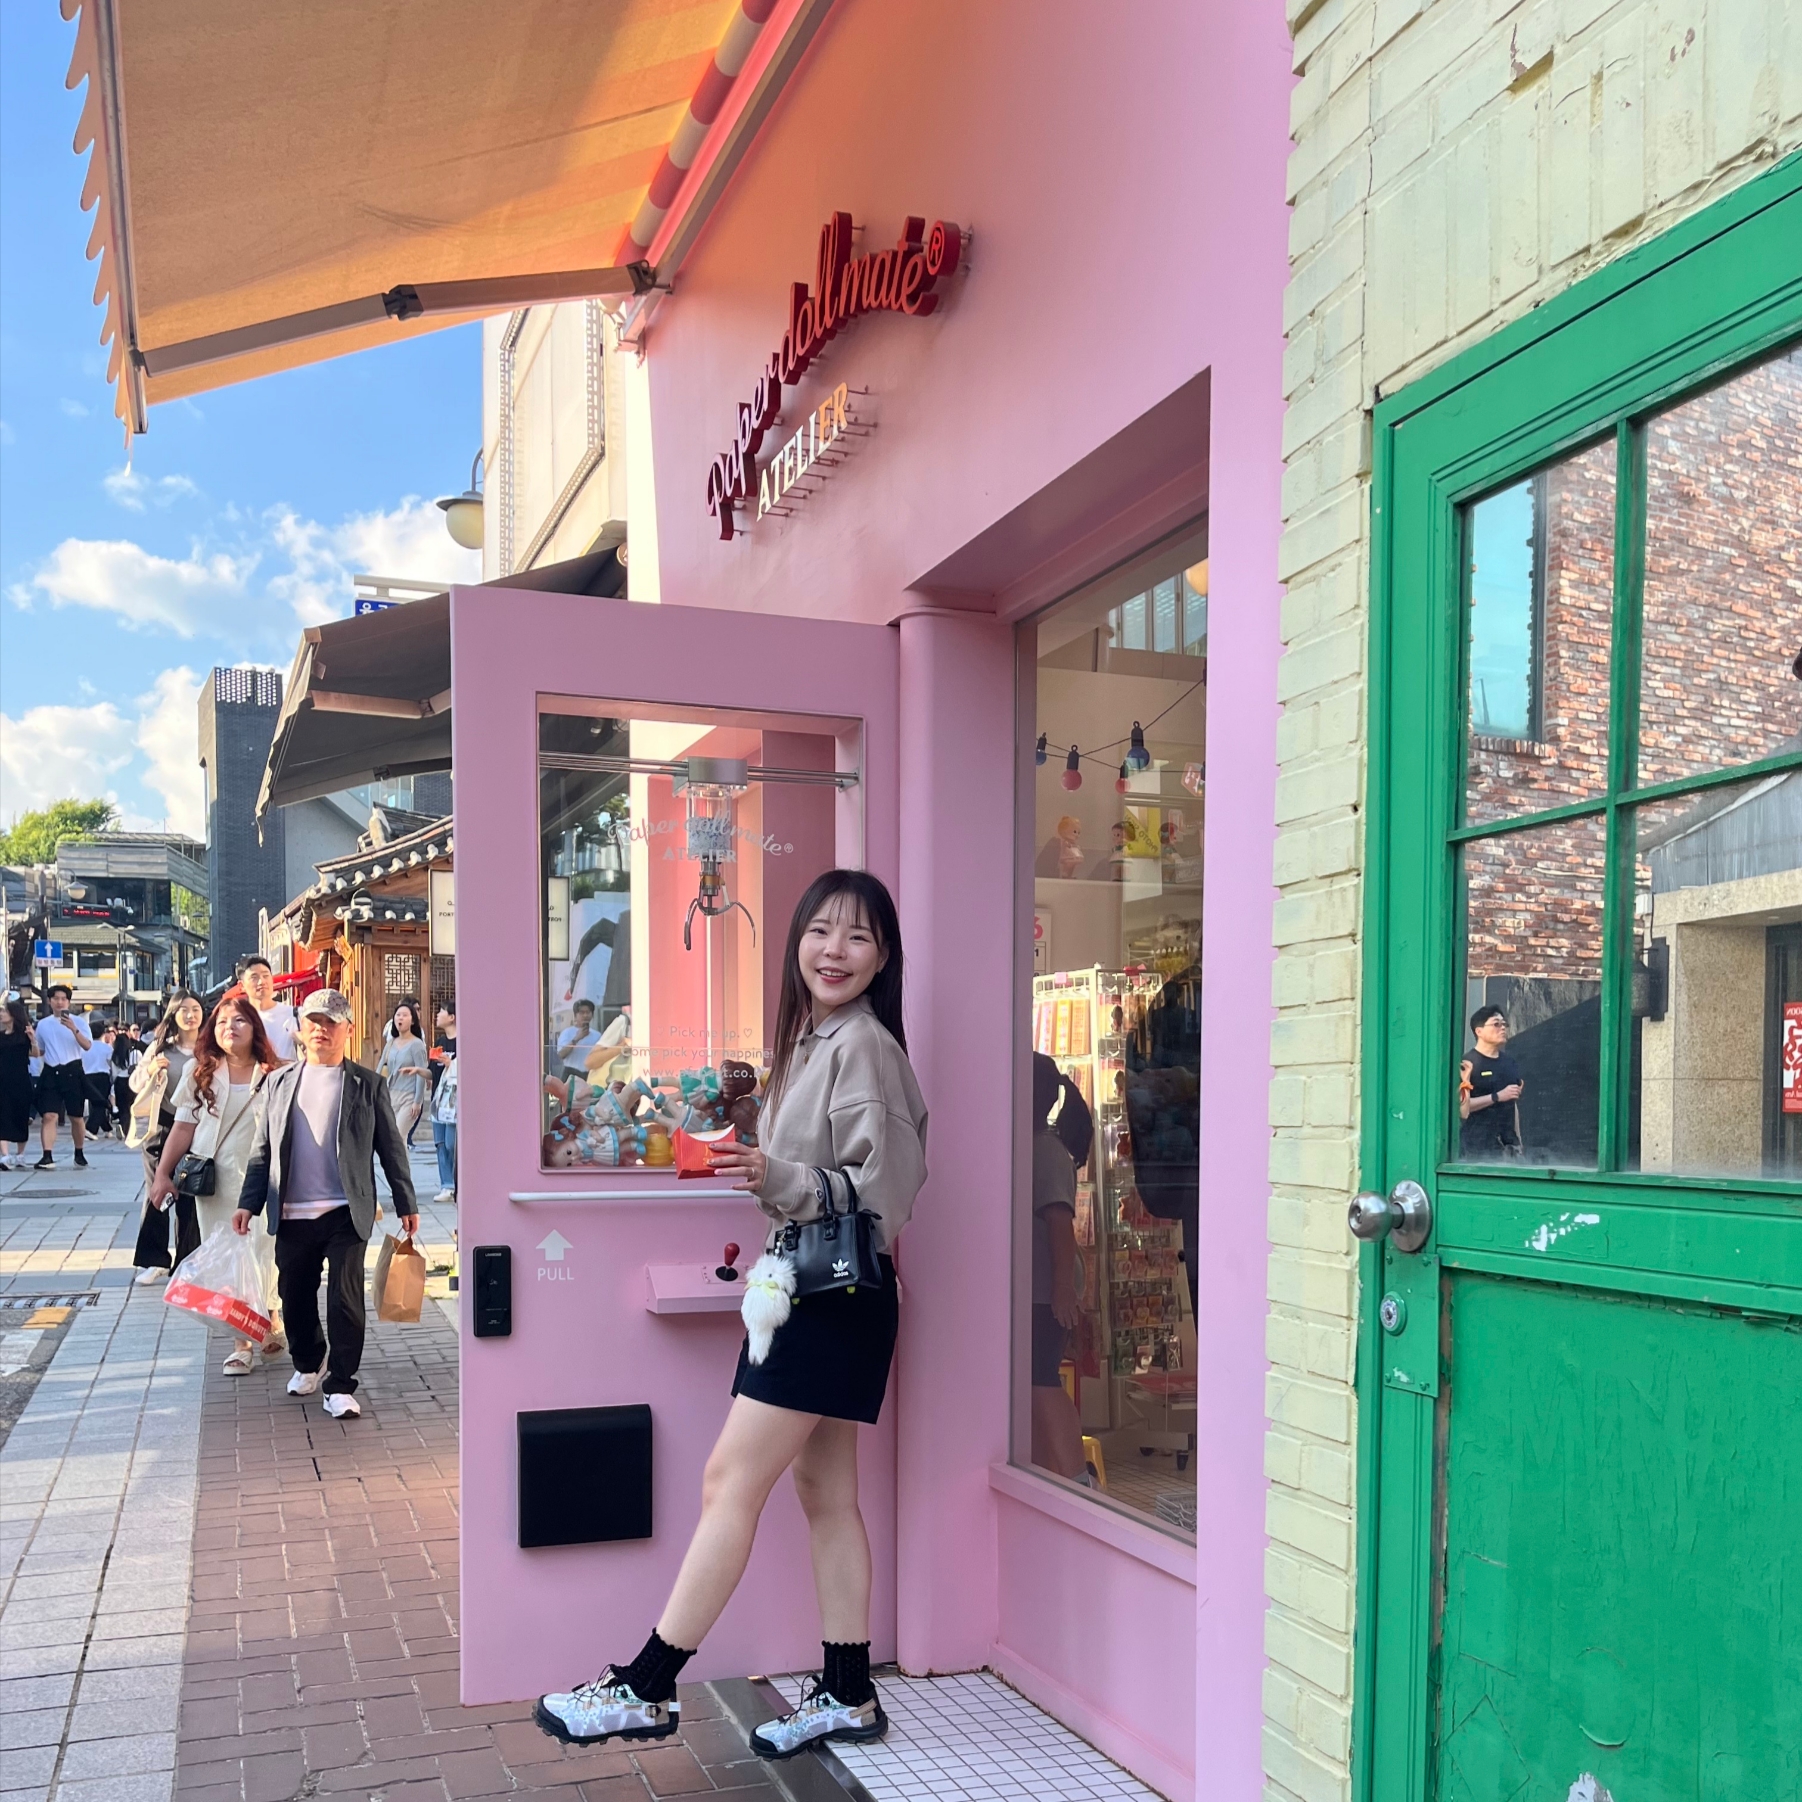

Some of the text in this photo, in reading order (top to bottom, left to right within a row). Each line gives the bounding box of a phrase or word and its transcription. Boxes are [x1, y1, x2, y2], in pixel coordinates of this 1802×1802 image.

[756, 382, 848, 522] ATELIER
[662, 847, 737, 863] ATELIER
[670, 1026, 740, 1041] Pick me up.
[621, 1047, 658, 1057] Come
[662, 1047, 687, 1058] pick
[691, 1049, 718, 1060] your
[537, 1267, 575, 1281] PULL
